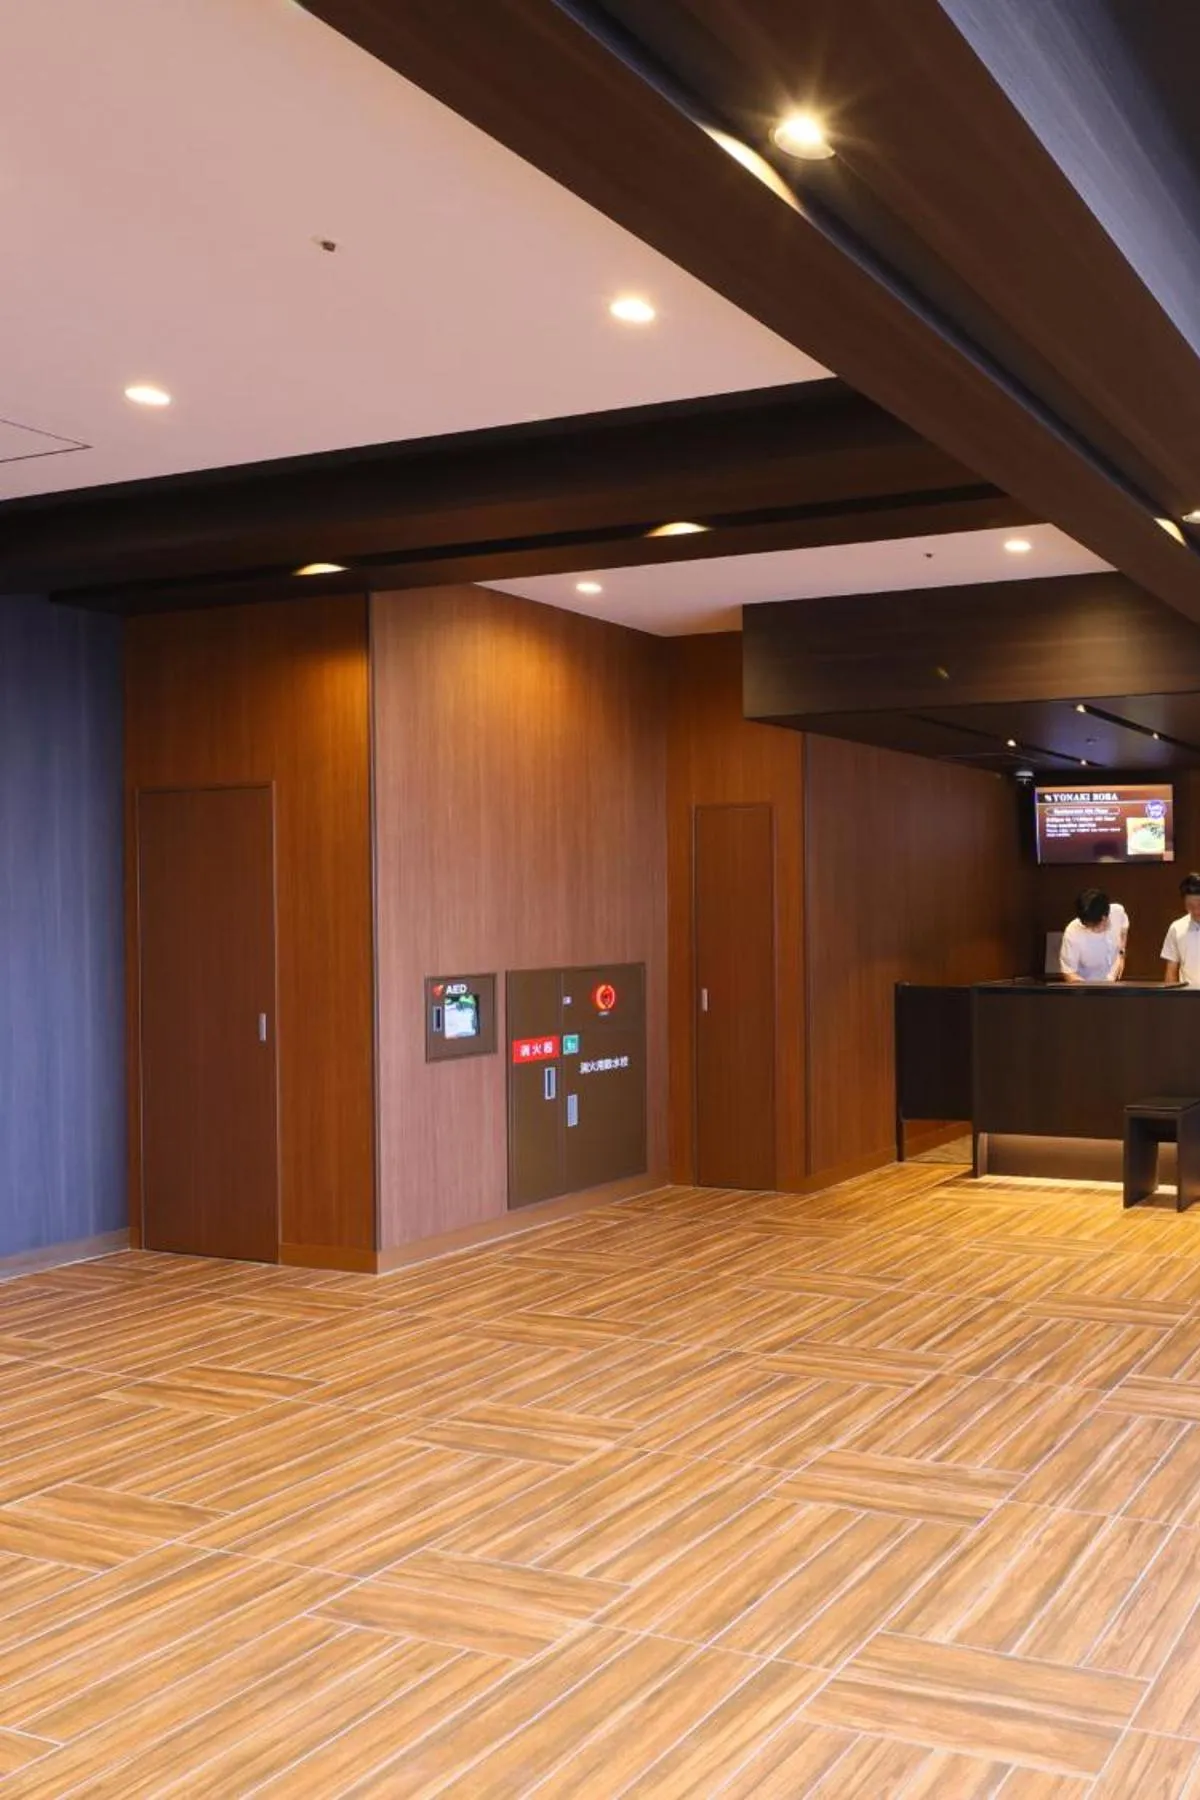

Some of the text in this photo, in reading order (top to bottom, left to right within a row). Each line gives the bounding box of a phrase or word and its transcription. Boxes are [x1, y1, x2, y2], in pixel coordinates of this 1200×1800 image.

[1053, 793, 1118, 801] YONAKI SOBA
[446, 984, 468, 994] AED
[520, 1041, 553, 1057] 消火器
